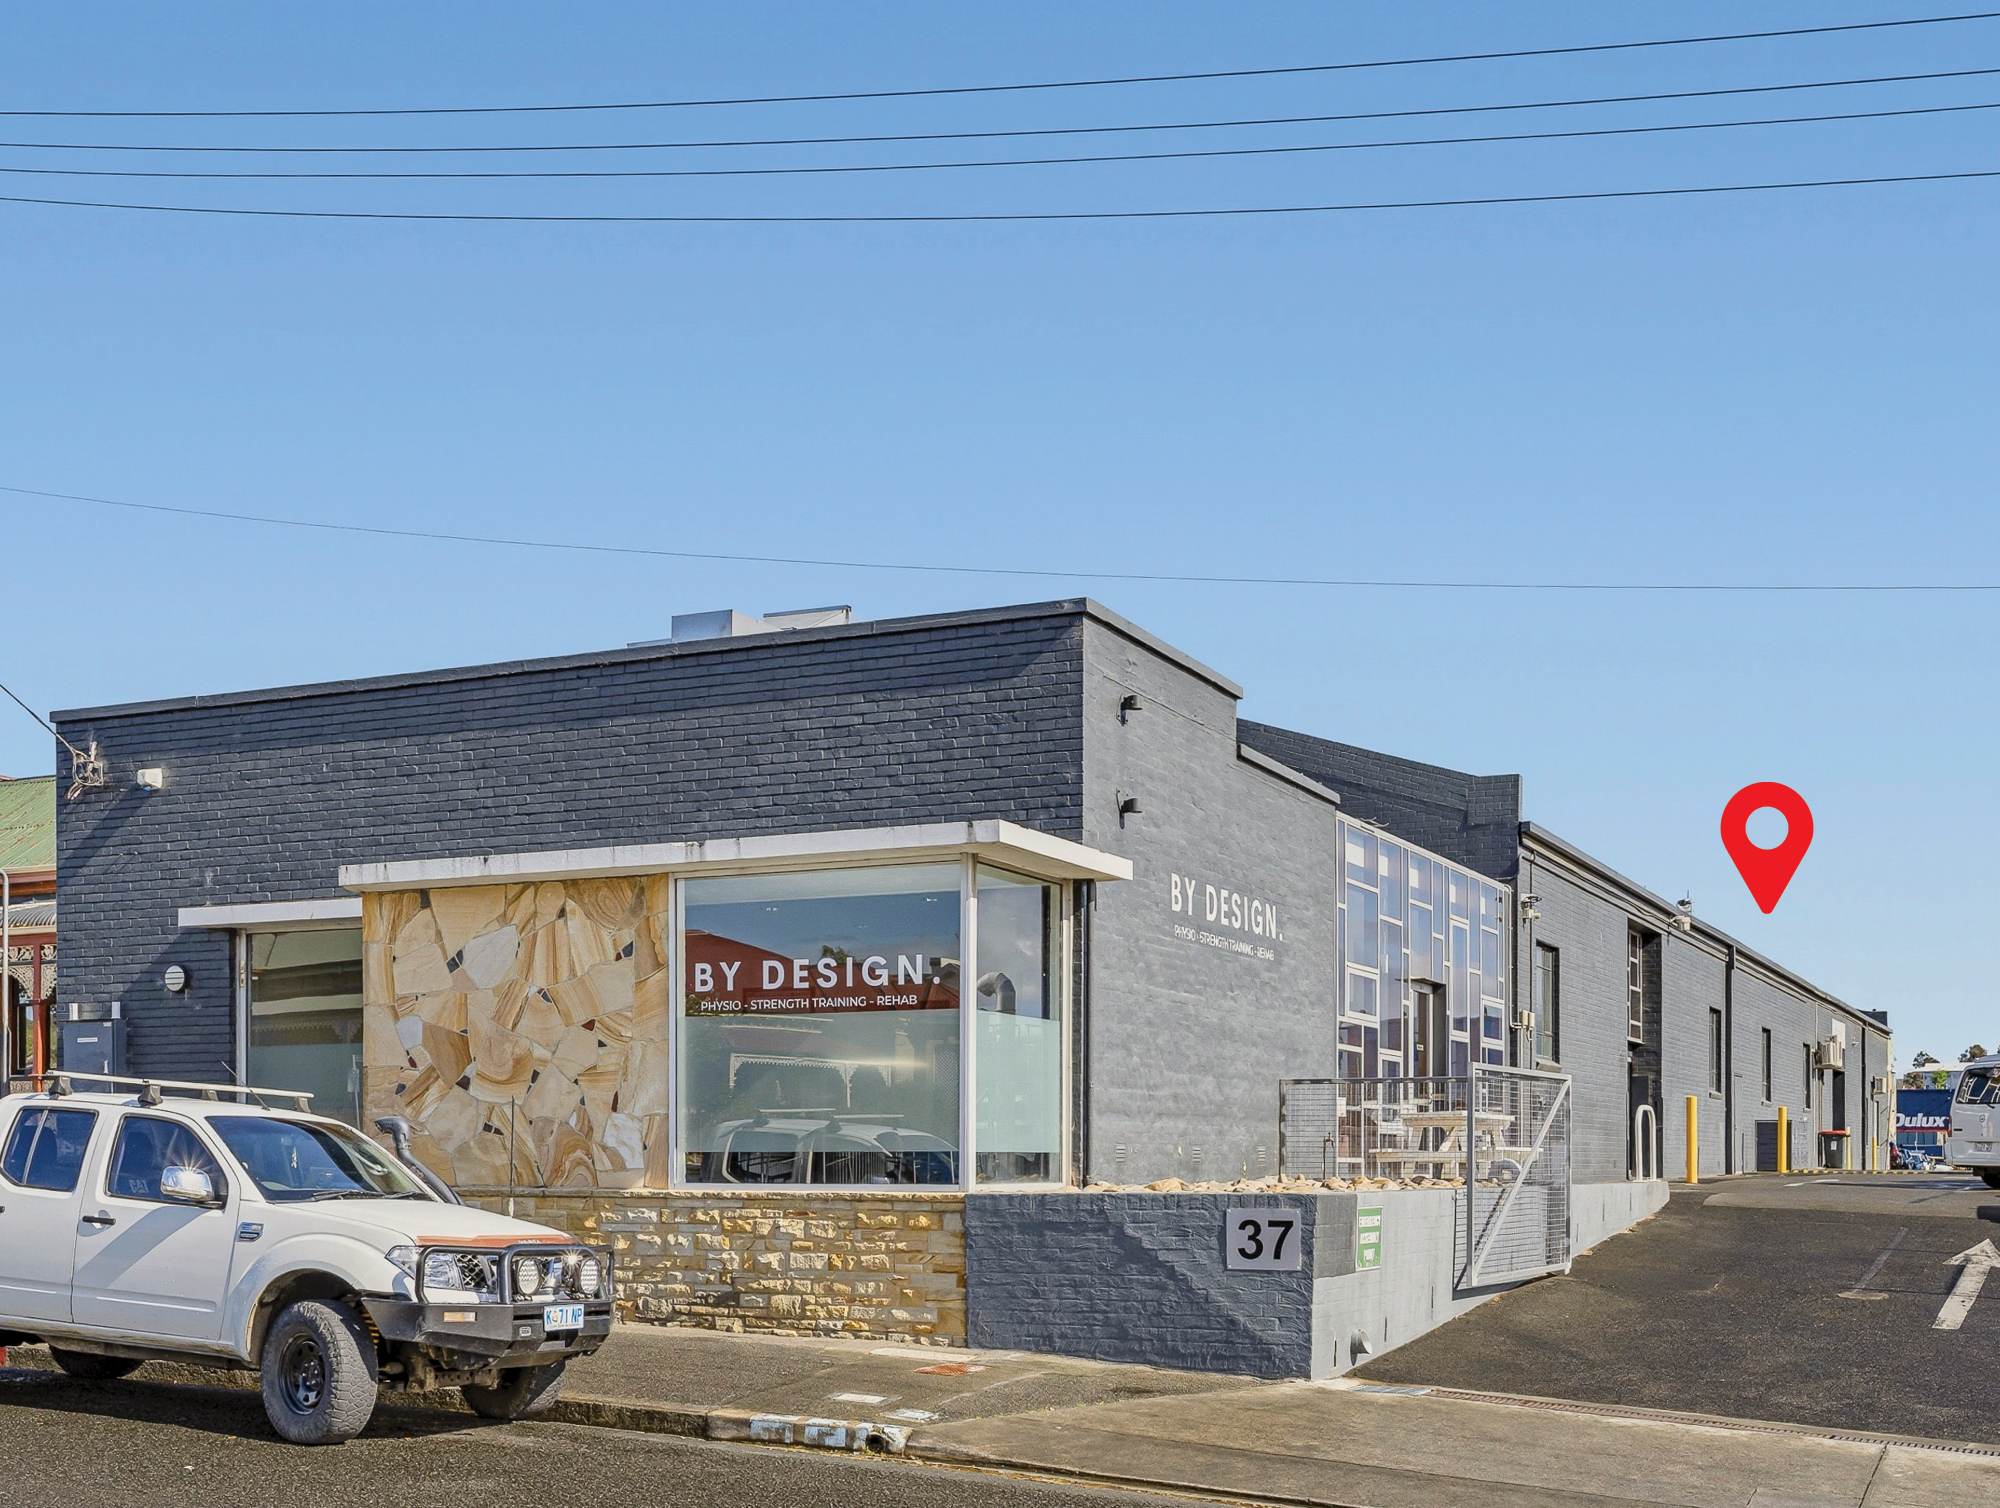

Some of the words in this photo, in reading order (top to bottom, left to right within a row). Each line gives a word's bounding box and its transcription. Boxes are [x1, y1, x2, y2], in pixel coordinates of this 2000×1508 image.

[1171, 872, 1196, 916] BY
[1205, 884, 1283, 941] DESIGN.
[1174, 925, 1196, 941] PHYSIO
[1200, 932, 1228, 950] STRENGTH
[1228, 939, 1254, 956] TRAINING
[1257, 946, 1275, 961] REHAB
[694, 961, 742, 992] BY
[762, 954, 941, 990] DESIGN.
[701, 1000, 742, 1011] PHYSIO
[750, 998, 809, 1010] STRENGTH
[811, 995, 867, 1008] TRAINING
[877, 994, 918, 1006] REHAB
[1237, 1219, 1294, 1260] 37
